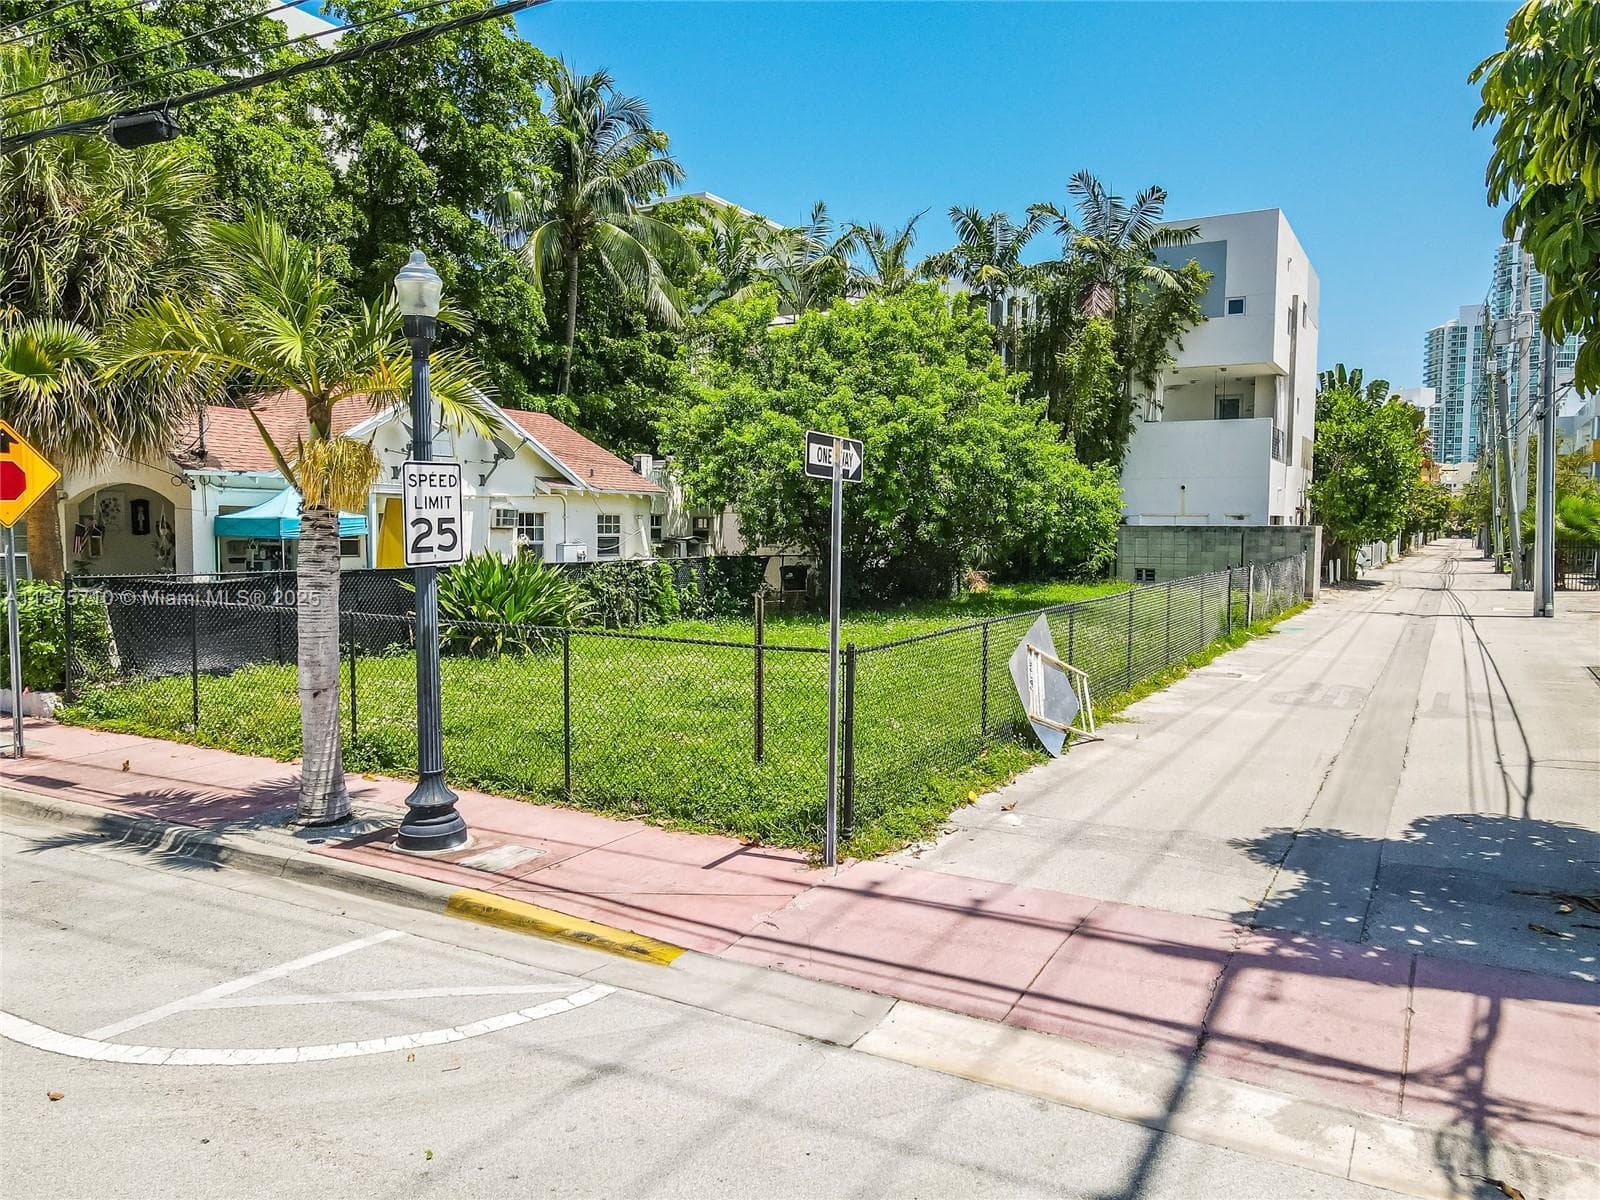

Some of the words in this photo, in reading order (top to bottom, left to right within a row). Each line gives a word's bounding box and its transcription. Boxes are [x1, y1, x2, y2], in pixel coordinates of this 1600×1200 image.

[817, 446, 832, 464] ONE
[408, 473, 457, 488] SPEED
[414, 495, 452, 510] LIMIT
[410, 517, 458, 554] 25
